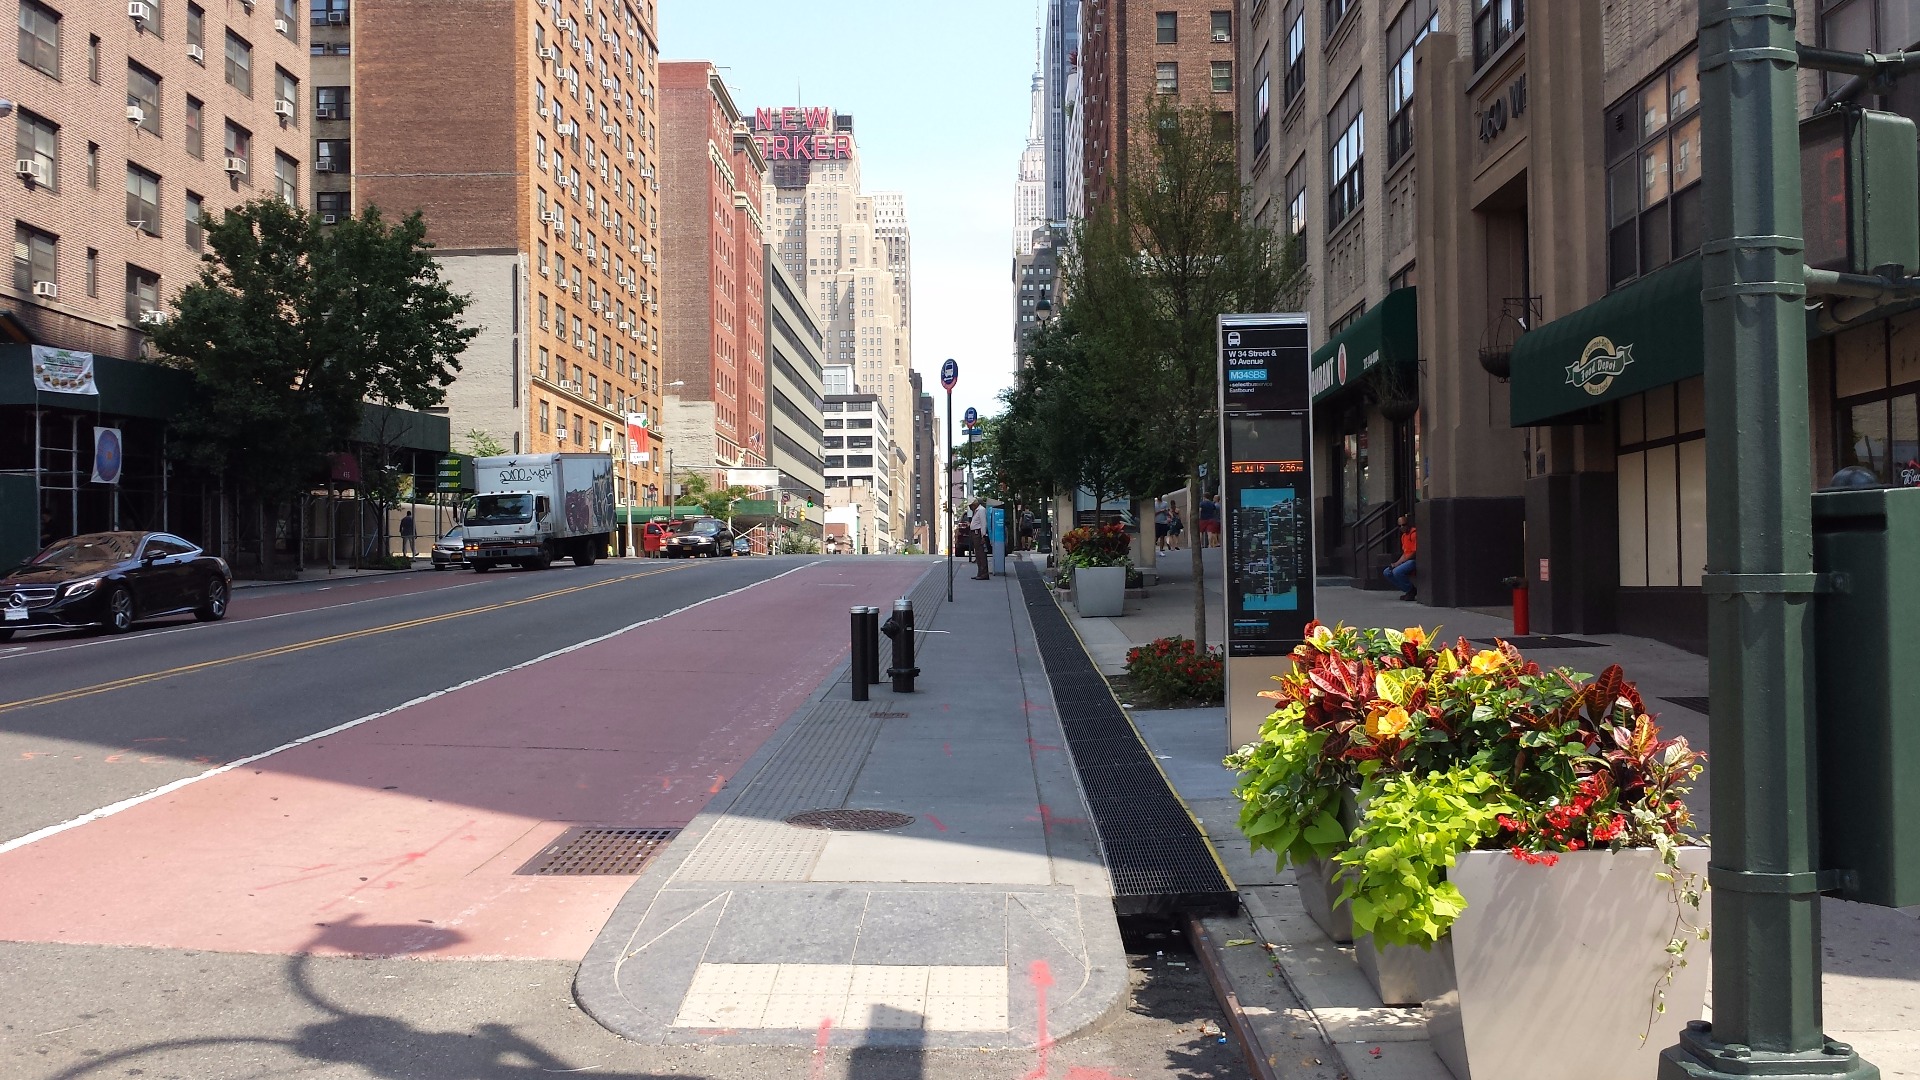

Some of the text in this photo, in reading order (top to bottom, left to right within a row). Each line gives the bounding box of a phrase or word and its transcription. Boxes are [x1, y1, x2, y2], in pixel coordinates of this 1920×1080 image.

[755, 106, 829, 131] NEW
[1479, 95, 1508, 145] 460
[753, 135, 853, 160] ORKER
[1228, 350, 1237, 358] W
[1247, 349, 1270, 357] Street
[1270, 349, 1277, 357] &
[1230, 370, 1266, 379] M34SBS
[1597, 359, 1616, 376] Depot
